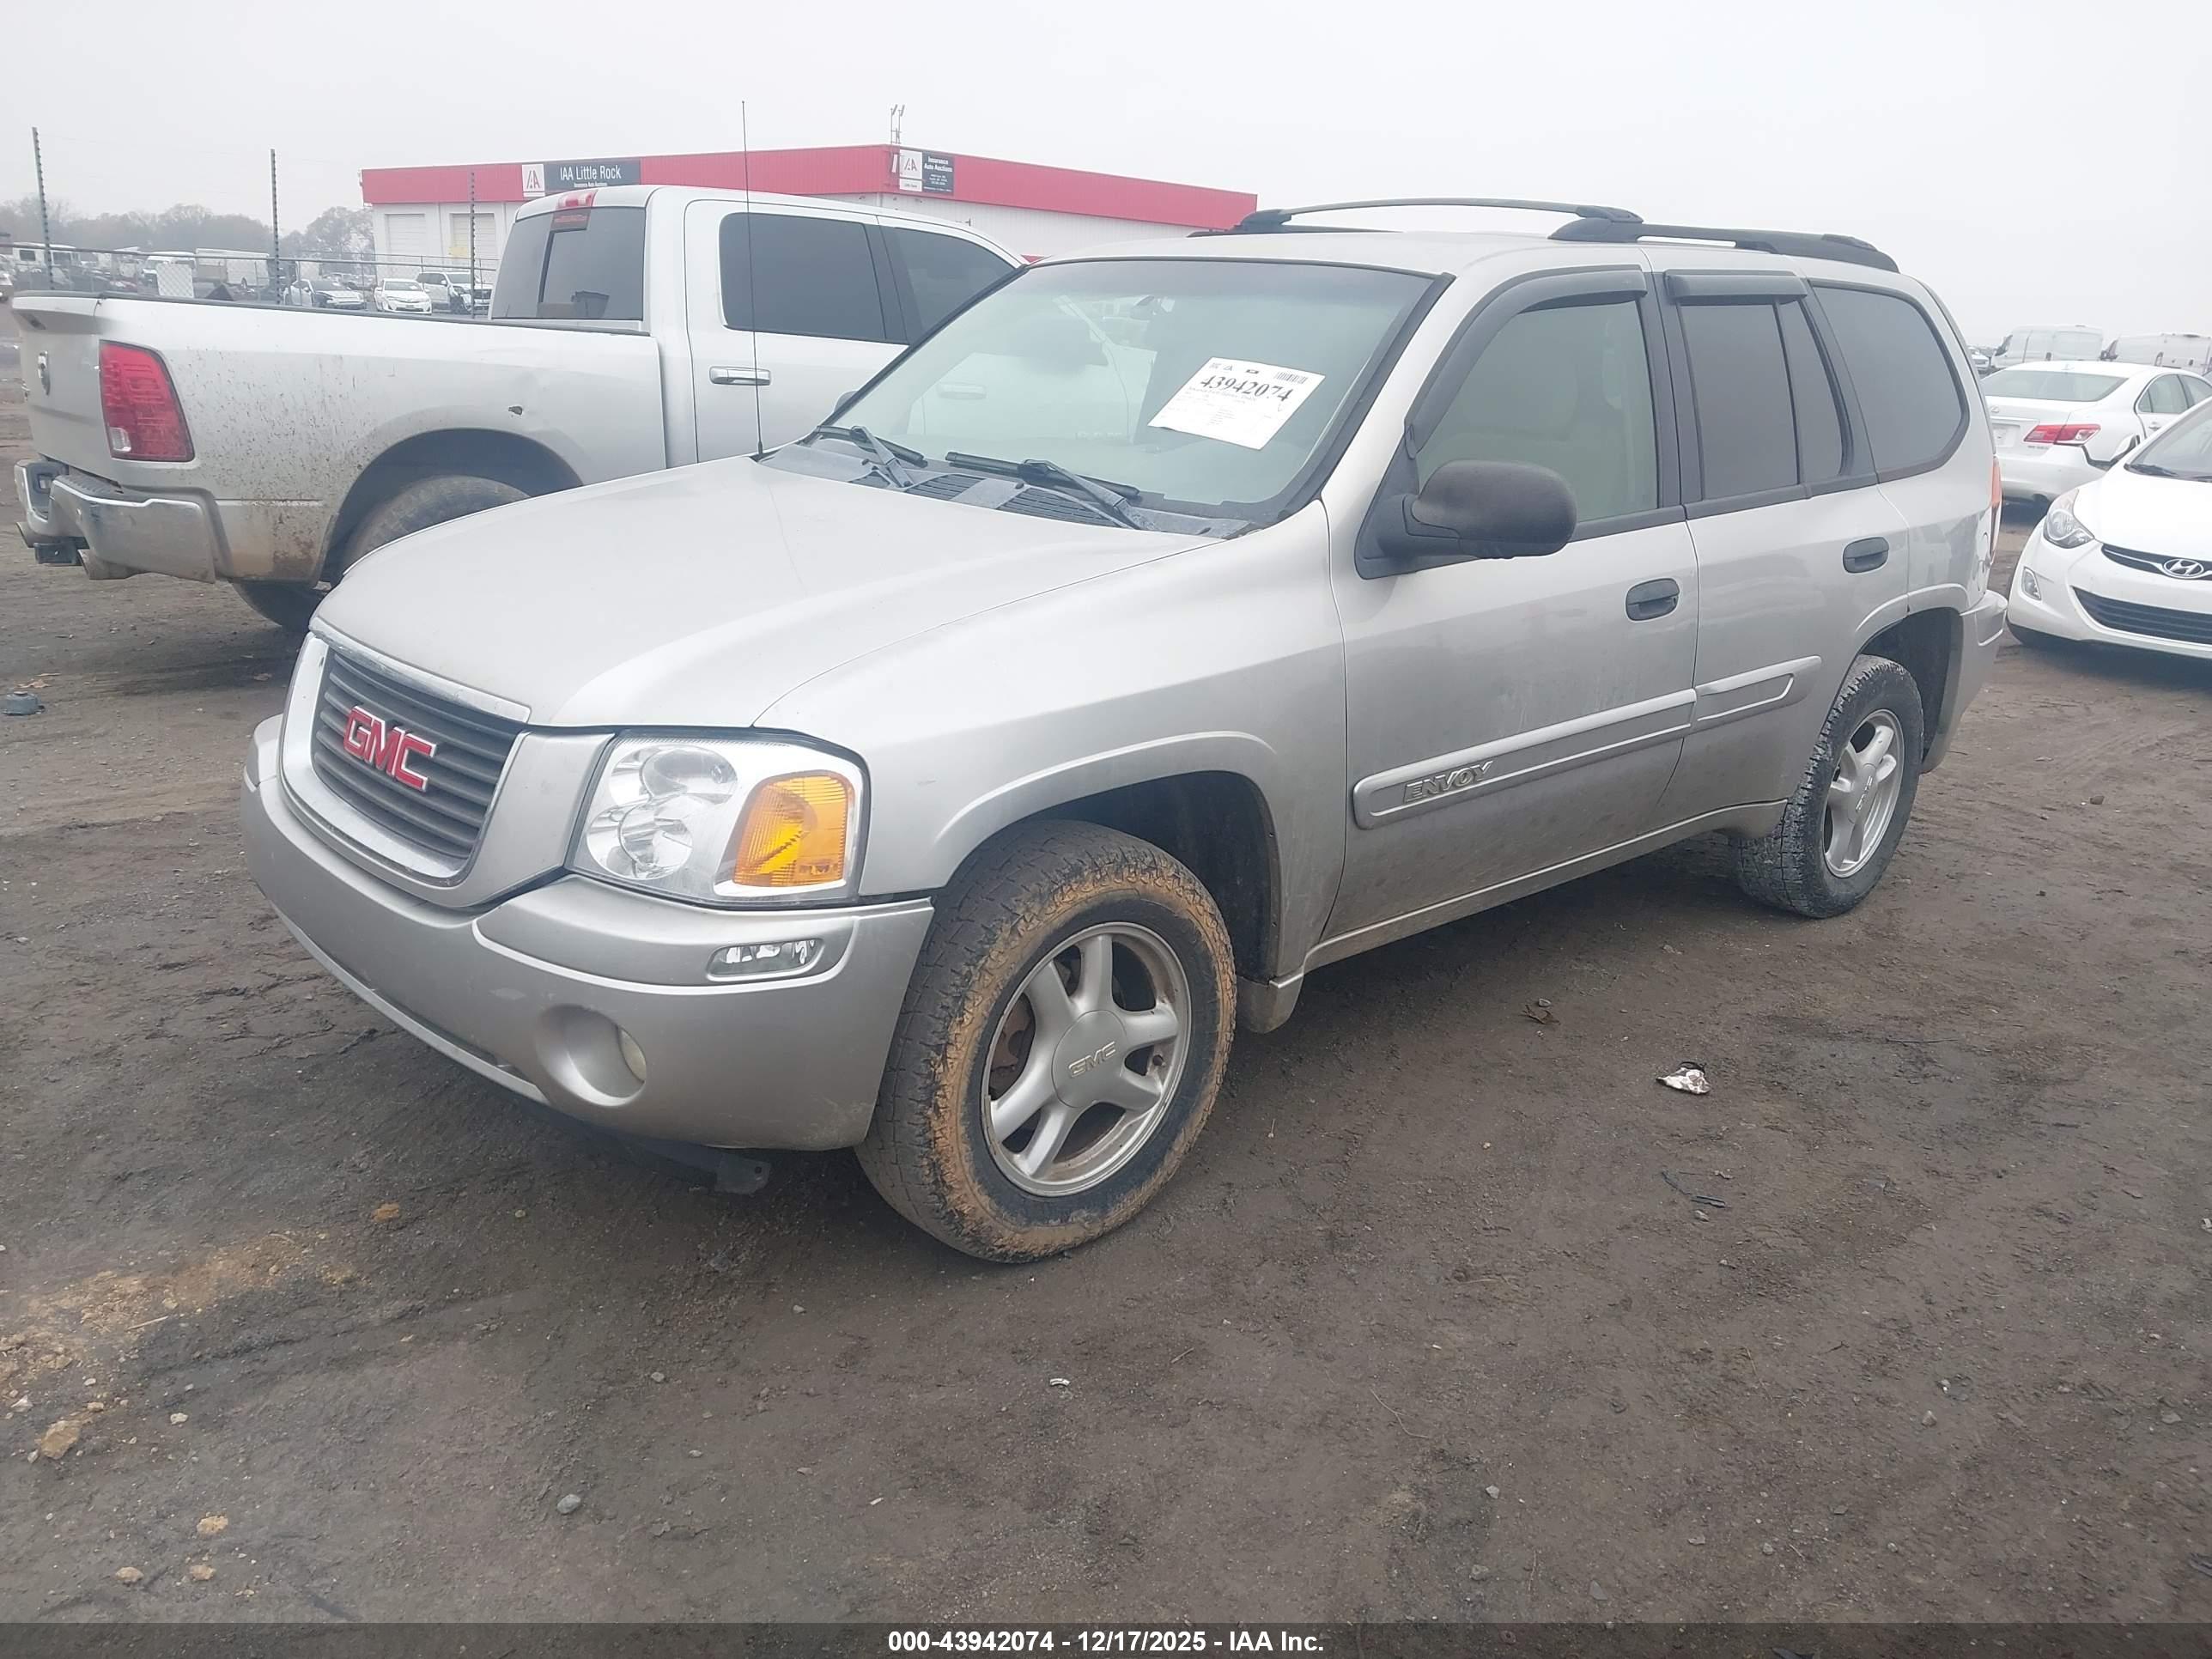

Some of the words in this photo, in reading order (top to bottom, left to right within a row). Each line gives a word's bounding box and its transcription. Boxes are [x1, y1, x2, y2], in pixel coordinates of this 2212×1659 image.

[560, 167, 574, 180] IAA
[576, 166, 598, 180] Little
[600, 164, 622, 179] Rock
[1200, 374, 1294, 402] 43942074
[343, 706, 437, 793] GMC
[1402, 760, 1494, 804] ENVOY
[1068, 1040, 1116, 1078] GMC
